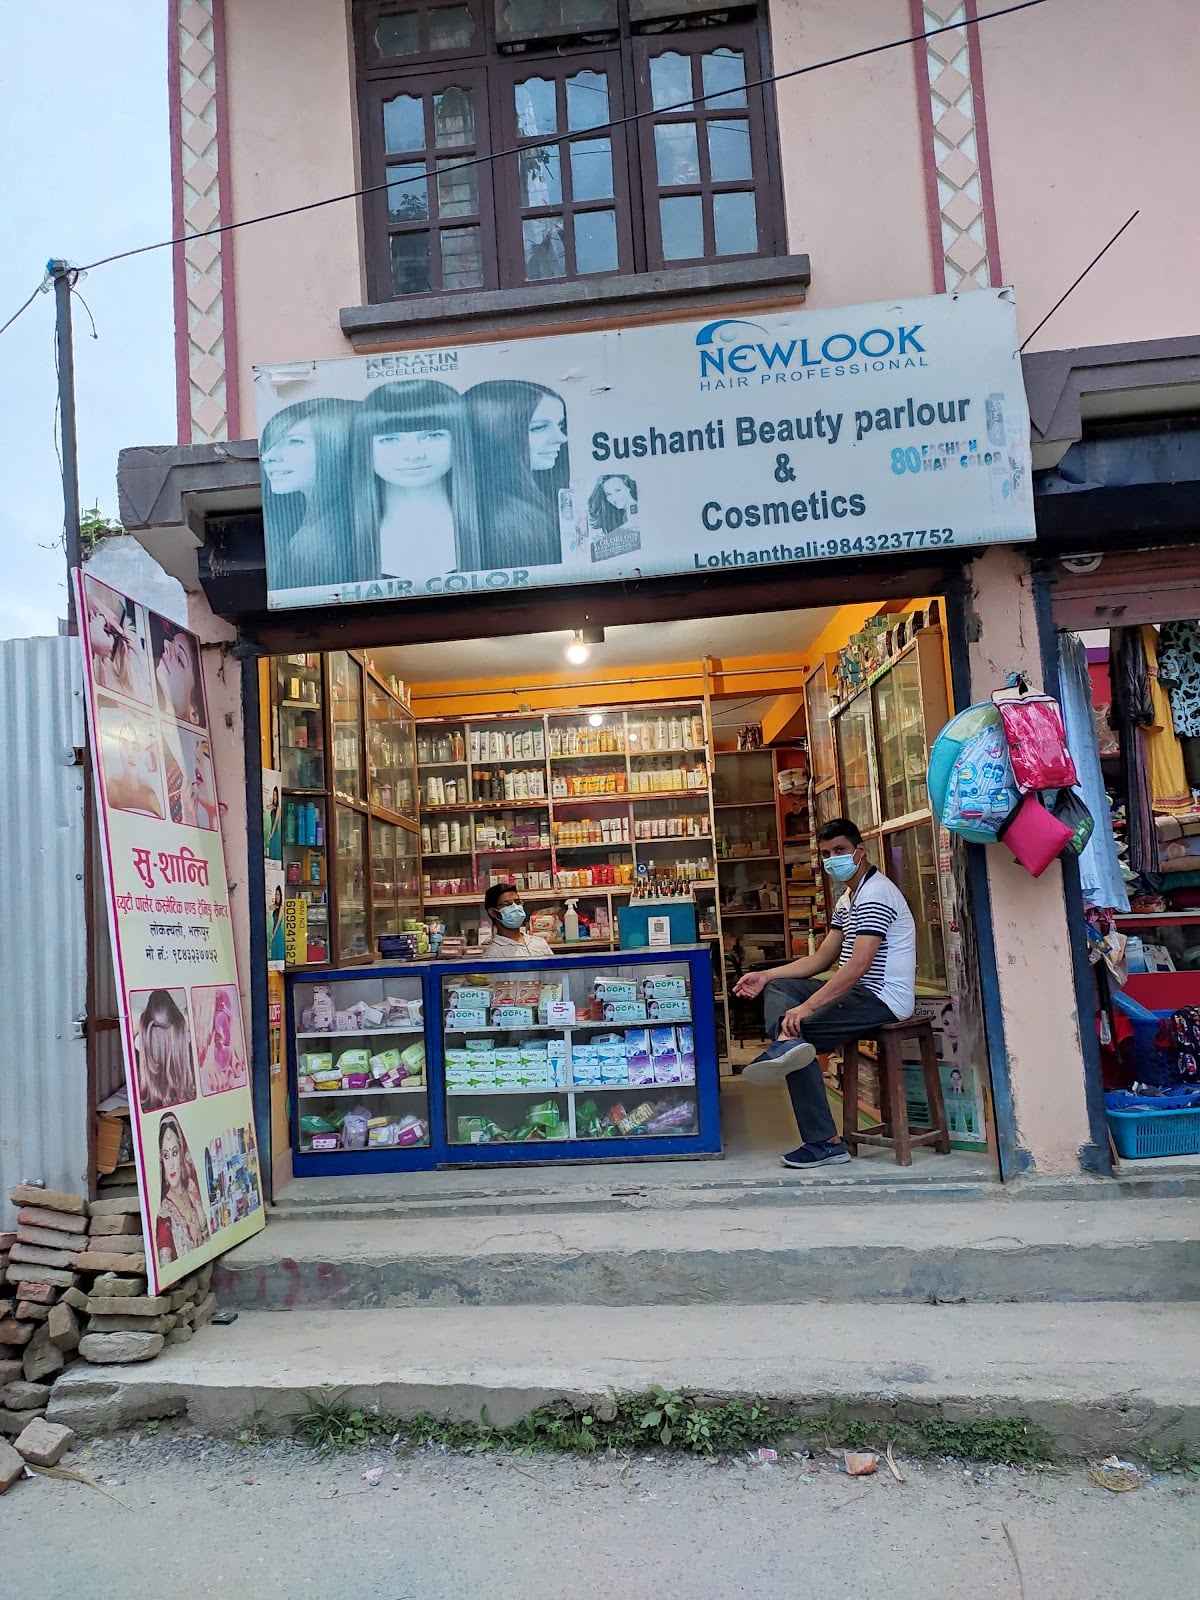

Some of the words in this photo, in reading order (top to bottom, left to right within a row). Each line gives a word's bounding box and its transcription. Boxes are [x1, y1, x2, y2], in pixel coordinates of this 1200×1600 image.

[366, 351, 458, 371] KERATIN
[699, 324, 926, 378] NEWLOOK
[366, 363, 459, 379] EXCELLENCE
[700, 376, 749, 392] HAIR
[761, 356, 929, 384] PROFESSIONAL
[591, 420, 724, 462] Sushanti
[736, 411, 843, 447] Beauty
[855, 396, 970, 441] parlour
[774, 453, 797, 483] &
[891, 446, 921, 475] 80
[701, 491, 866, 531] Cosmetics
[694, 528, 954, 570] Lokhanthali:9843237752
[341, 579, 414, 601] HAIR
[425, 569, 530, 594] COLOR
